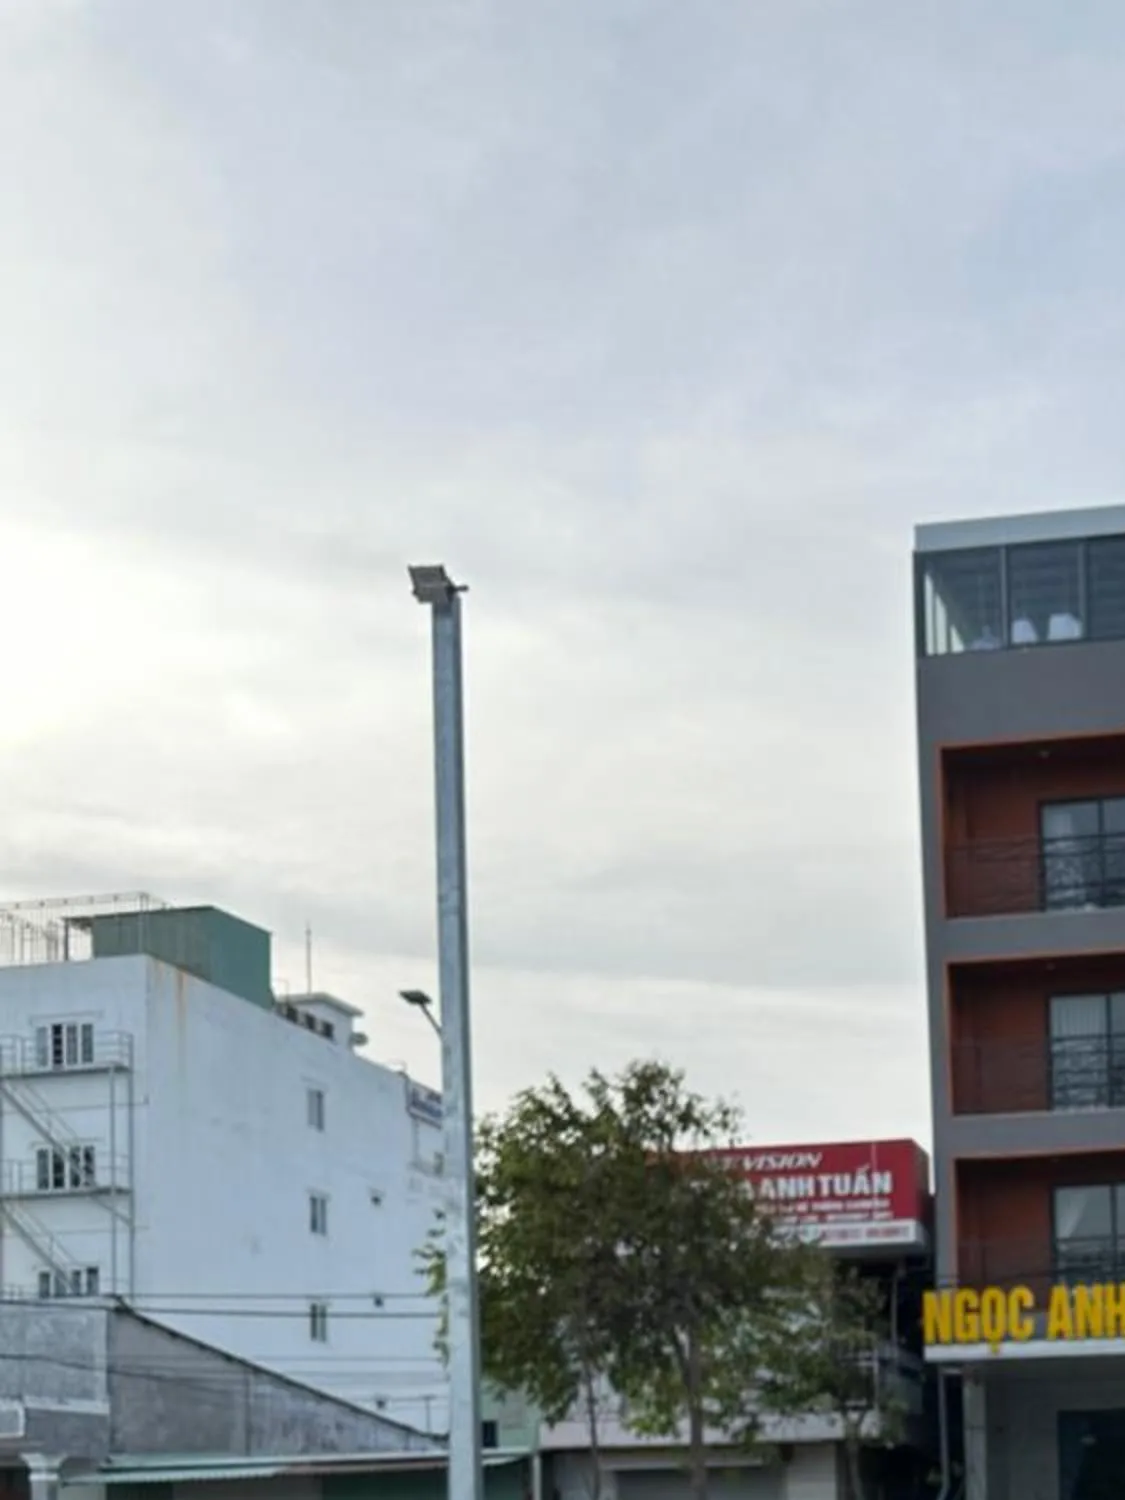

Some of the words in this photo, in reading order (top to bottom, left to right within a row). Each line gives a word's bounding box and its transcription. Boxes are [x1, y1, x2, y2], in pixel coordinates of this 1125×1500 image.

[760, 1173, 814, 1198] ANH
[819, 1164, 893, 1196] TUẤN
[923, 1286, 1035, 1356] NGỌC
